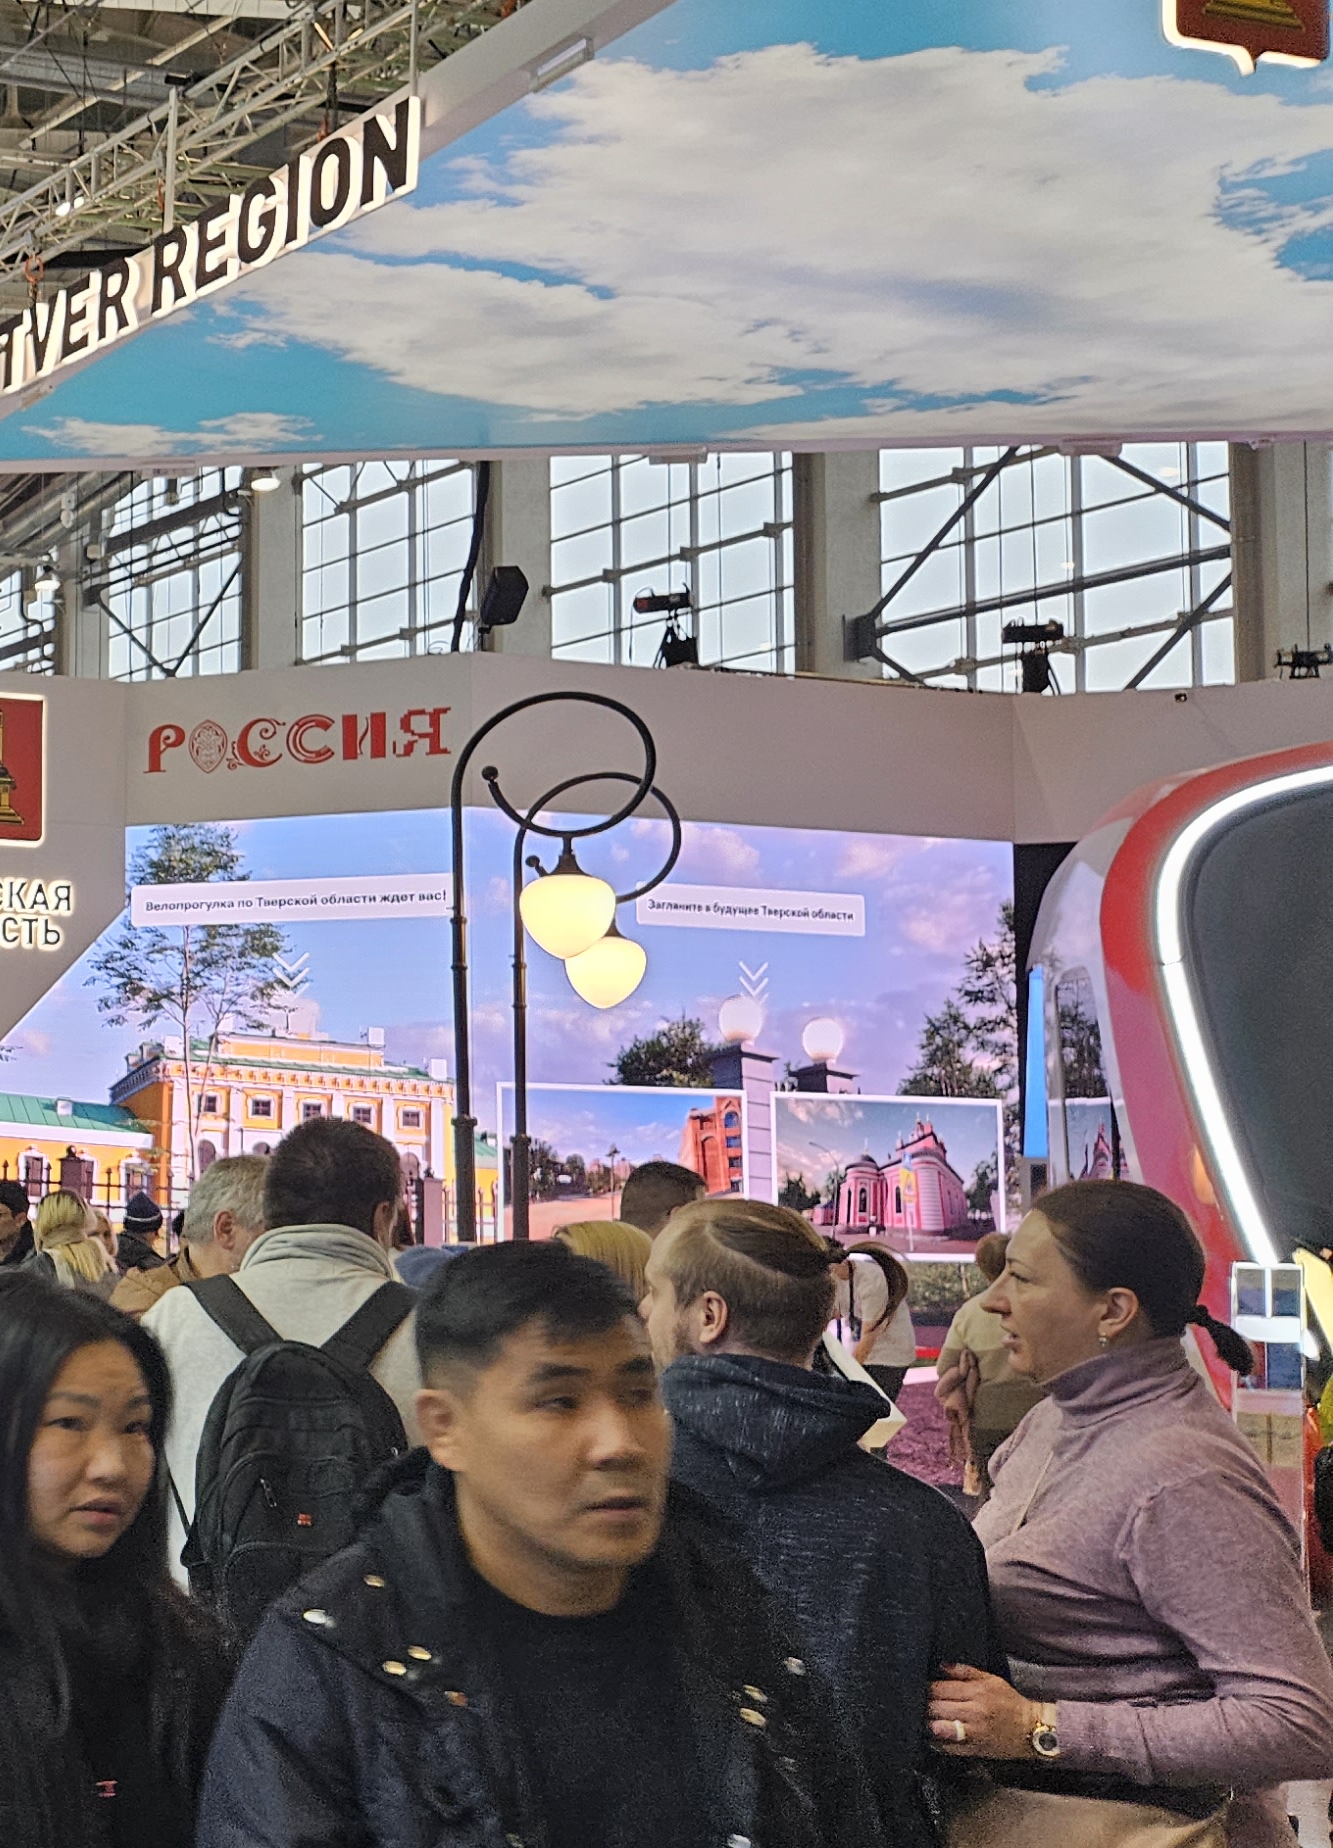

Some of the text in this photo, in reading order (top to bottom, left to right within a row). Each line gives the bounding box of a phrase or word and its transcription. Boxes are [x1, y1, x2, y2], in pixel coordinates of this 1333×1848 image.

[152, 97, 418, 318] REGION
[143, 706, 452, 774] РОССИЯ
[145, 889, 447, 913] Велопрогулка по Тверской области ждет вас!
[647, 898, 703, 914] Загляните
[713, 903, 759, 919] будущее
[760, 905, 810, 921] Тверской
[811, 910, 854, 922] области
